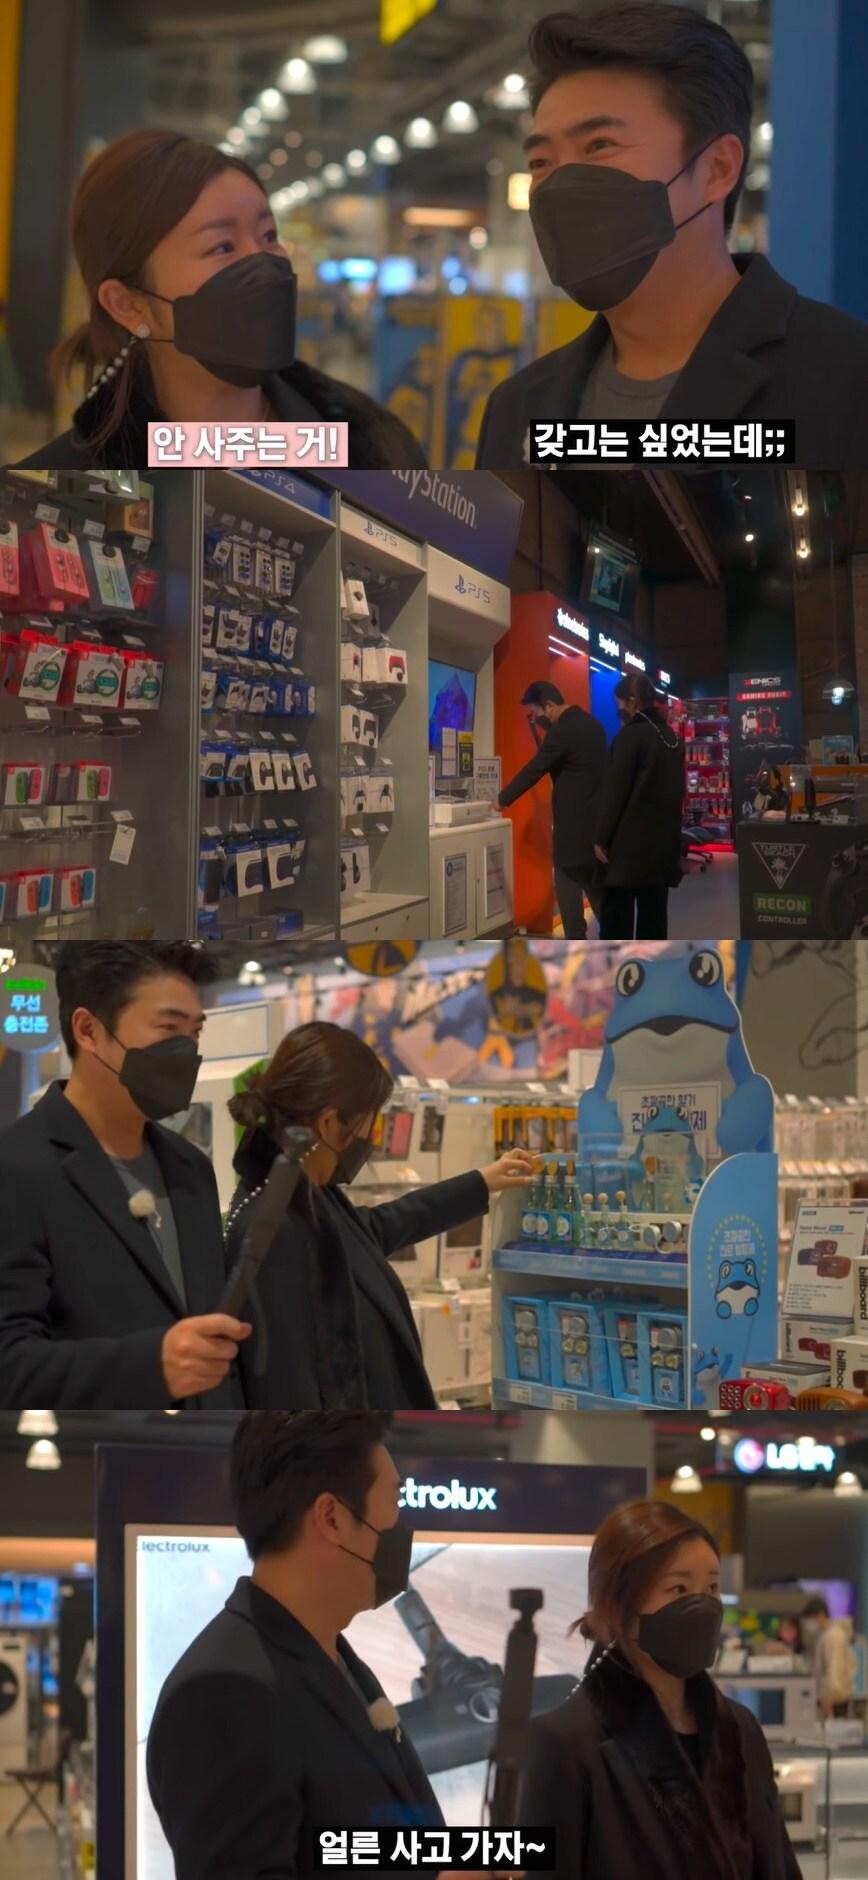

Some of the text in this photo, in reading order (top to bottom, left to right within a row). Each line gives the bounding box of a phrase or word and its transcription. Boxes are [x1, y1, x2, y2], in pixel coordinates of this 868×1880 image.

[392, 470, 476, 528] yStation
[467, 582, 491, 603] PS5
[757, 897, 806, 911] RECON
[142, 1541, 210, 1553] lectrolux
